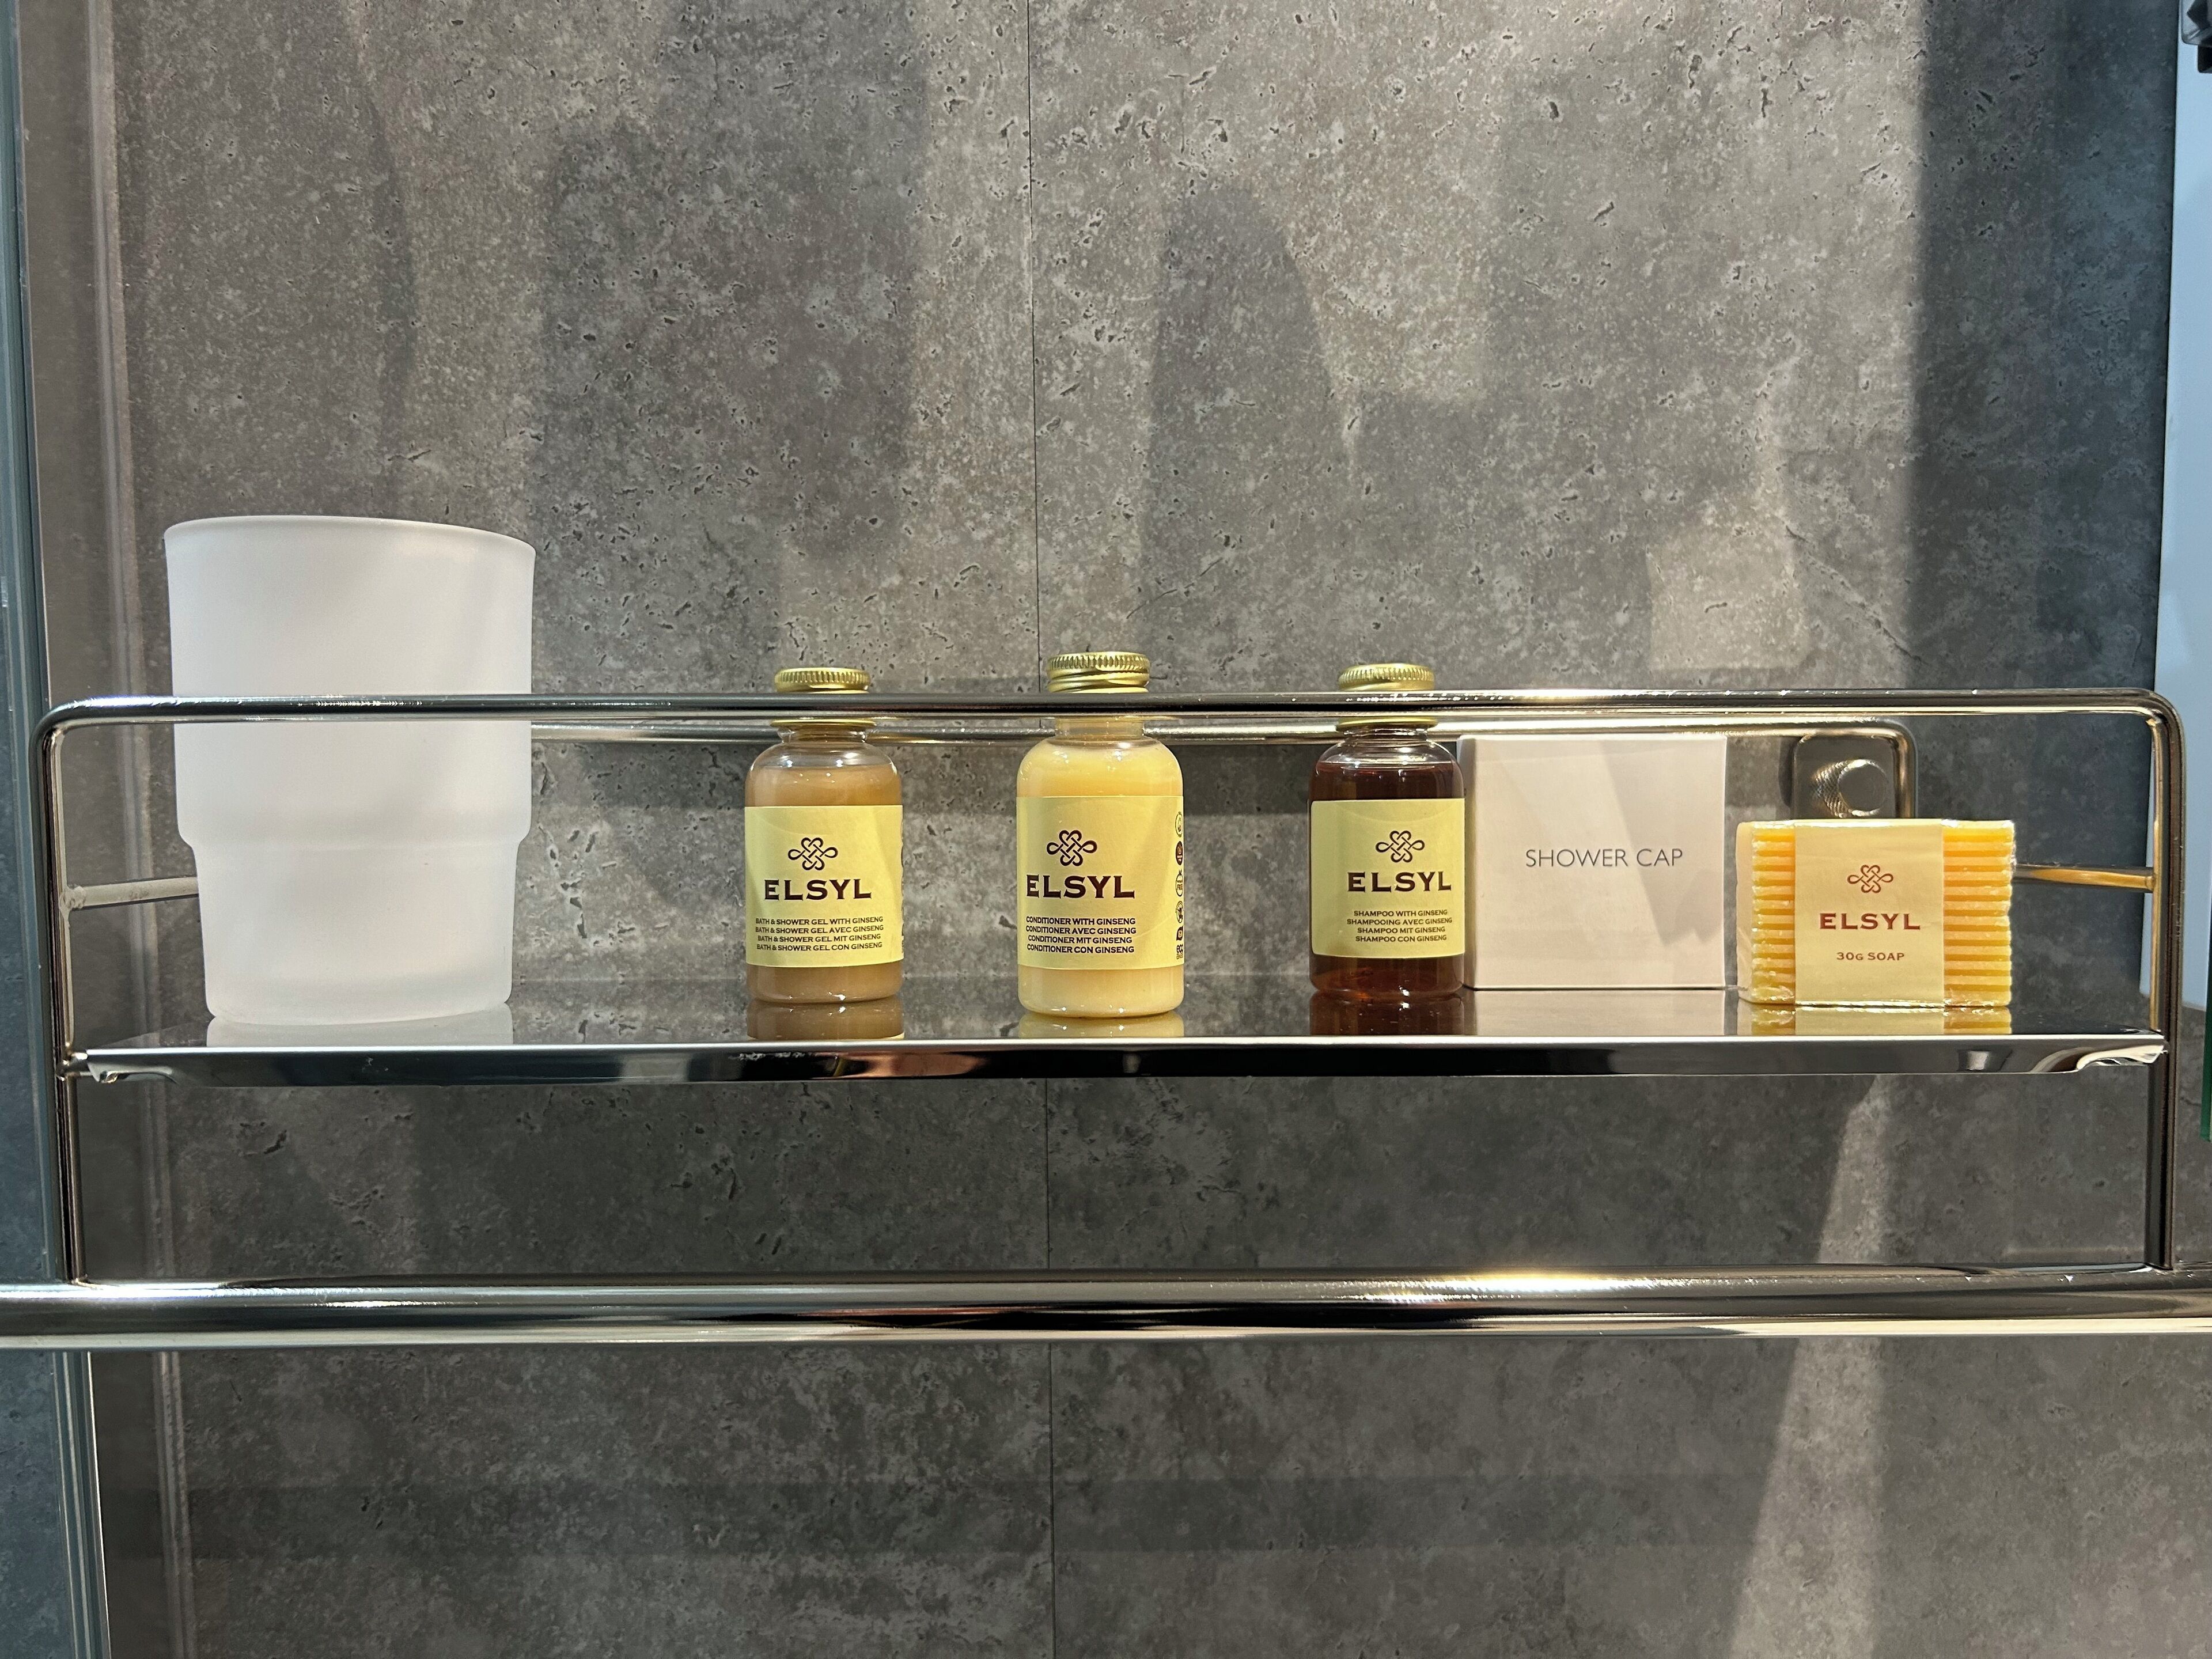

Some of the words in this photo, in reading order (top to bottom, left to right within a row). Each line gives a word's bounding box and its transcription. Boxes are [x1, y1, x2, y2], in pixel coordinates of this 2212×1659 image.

[1525, 849, 1628, 868] SHOWER
[1636, 848, 1683, 867] CAP
[1027, 874, 1135, 899] ELSYL
[1347, 871, 1452, 892] ELSYL
[764, 879, 872, 900] ELSYL
[1026, 916, 1071, 925] CONDITIONER
[1820, 913, 1920, 930] ELSYL
[1025, 926, 1070, 934] CONDITIONER
[1028, 935, 1075, 944] CONDITIONER
[1027, 944, 1073, 953] CONDITIONER
[1868, 952, 1905, 961] SOAP
